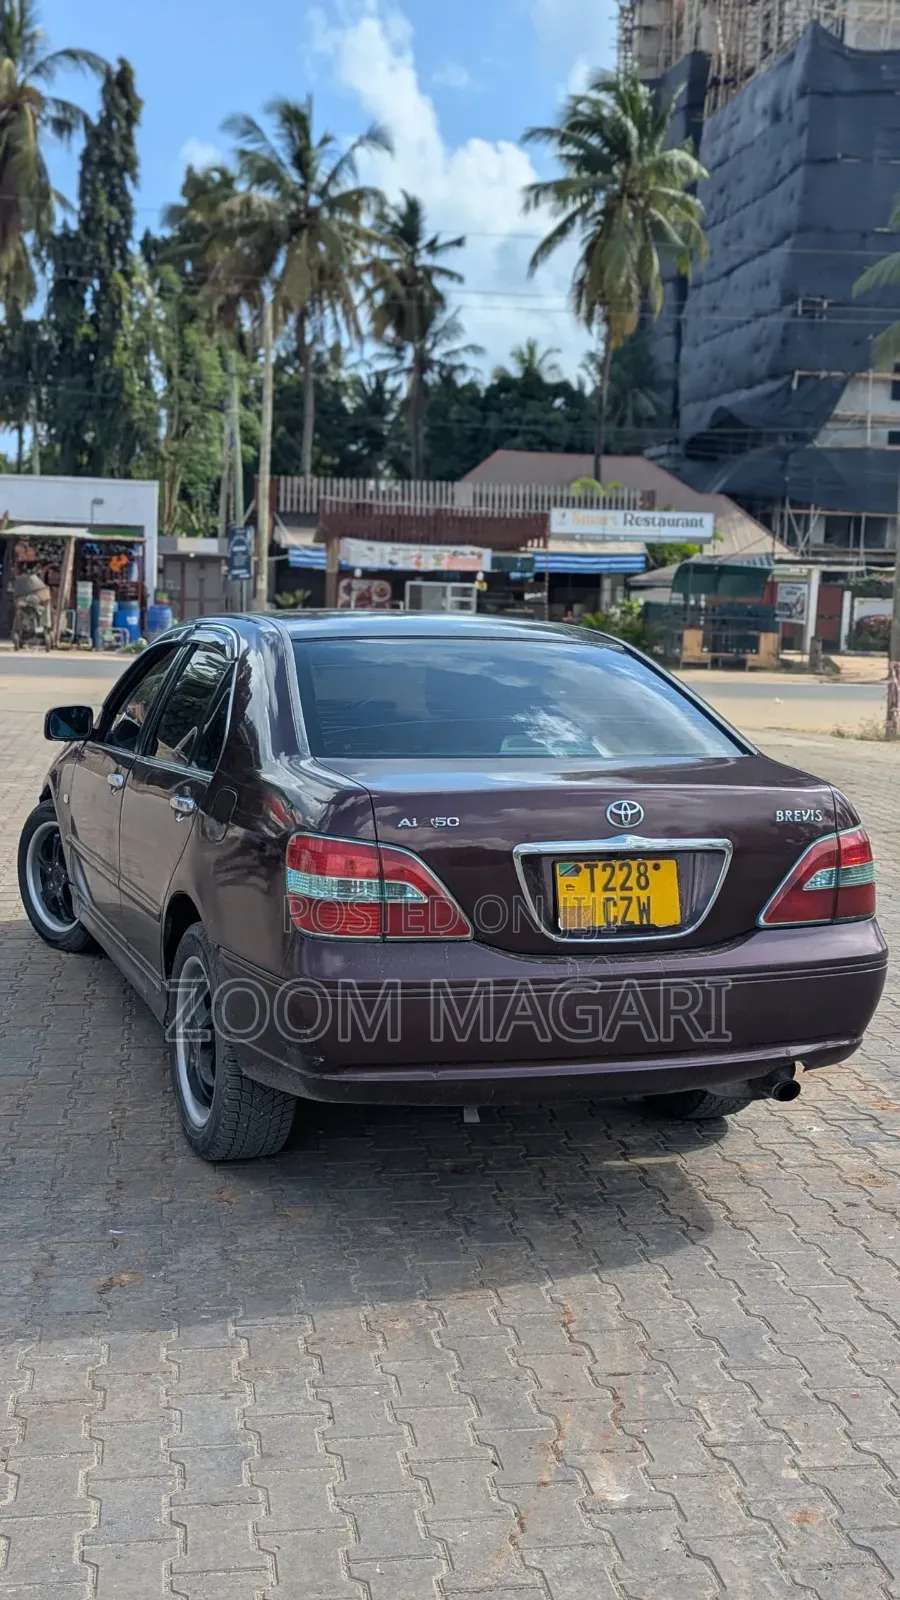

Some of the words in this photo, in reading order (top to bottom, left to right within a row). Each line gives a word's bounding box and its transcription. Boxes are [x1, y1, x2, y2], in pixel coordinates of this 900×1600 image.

[623, 512, 704, 528] Restaurant
[776, 809, 823, 822] BREVIS
[584, 862, 650, 892] T228
[603, 895, 651, 926] CZW
